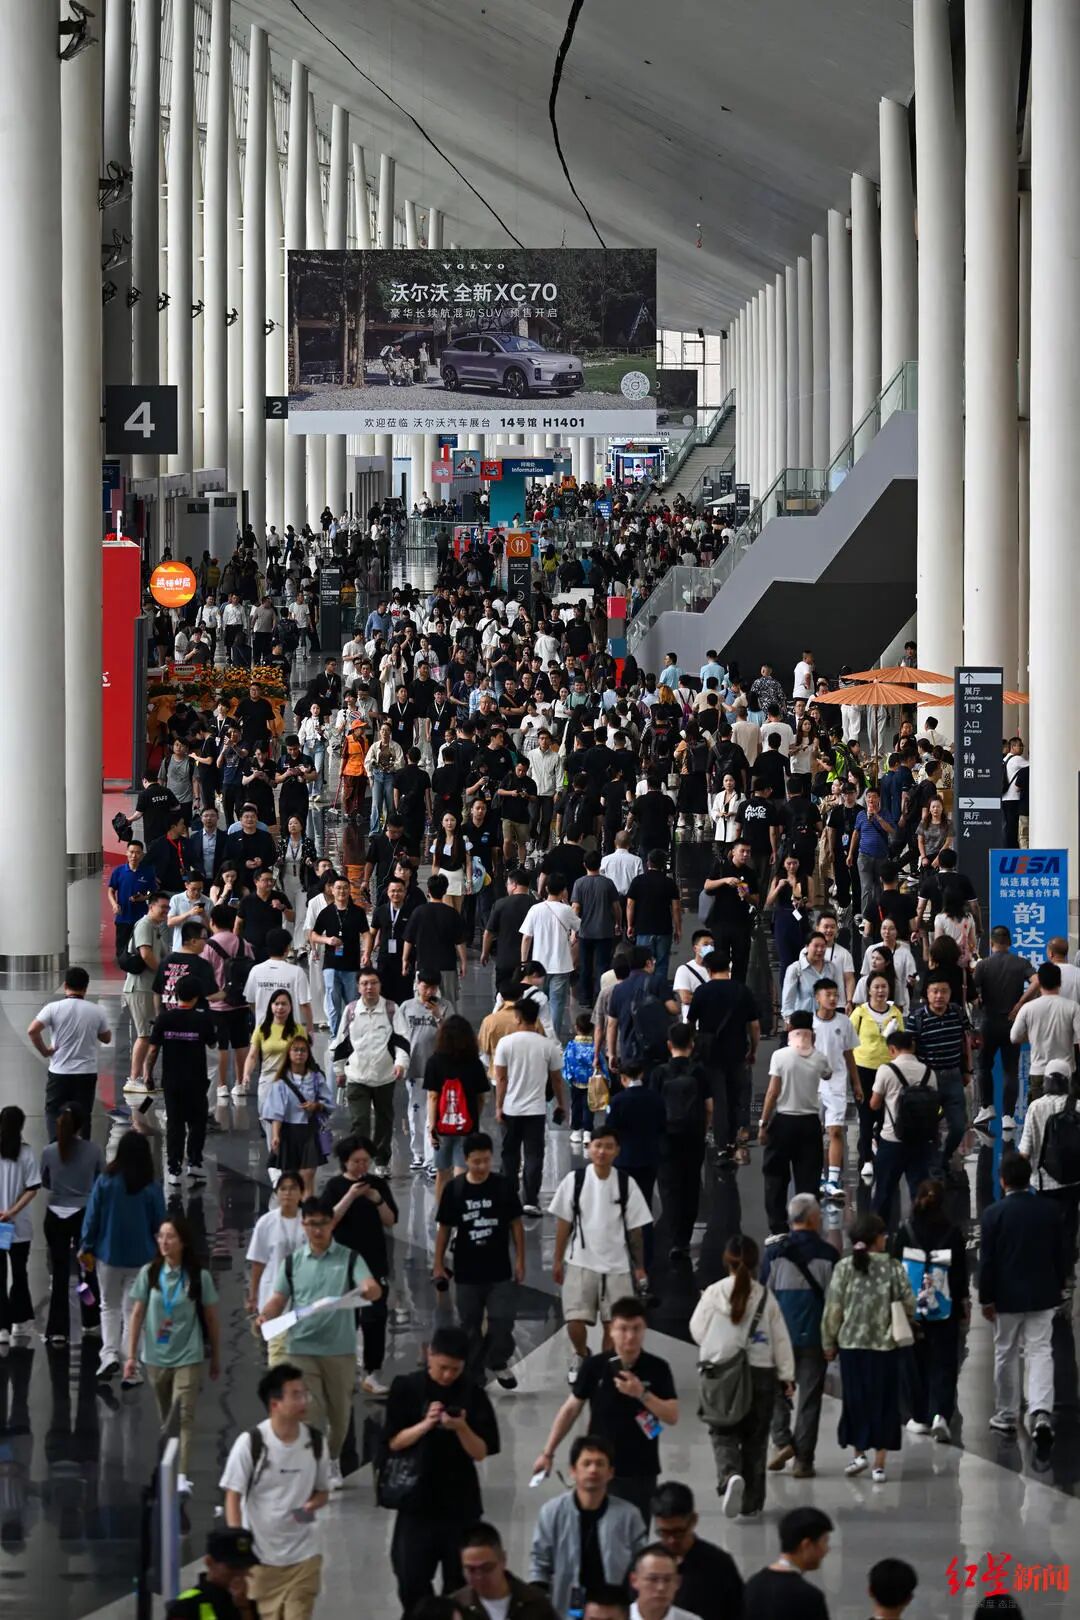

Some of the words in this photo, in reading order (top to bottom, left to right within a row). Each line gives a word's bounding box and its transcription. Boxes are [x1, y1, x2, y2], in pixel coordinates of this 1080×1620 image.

[390, 283, 449, 302] 沃尔沃
[390, 308, 502, 318] 豪华长续航混动SUV
[510, 308, 558, 318] 预售开启
[271, 401, 282, 414] 2
[123, 401, 155, 438] 4
[364, 418, 408, 428] 欢迎莅临
[413, 418, 491, 428] 沃尔沃汽车展台
[500, 417, 537, 428] 14号馆
[543, 417, 585, 428] H1401
[964, 687, 981, 696] 展厅
[964, 720, 980, 729] 入口
[963, 736, 972, 747] B
[963, 811, 980, 820] 展厅
[963, 827, 971, 838] 4
[1000, 889, 1060, 898] 指定快递合作商
[465, 1199, 481, 1211] Yes
[482, 1198, 493, 1209] to
